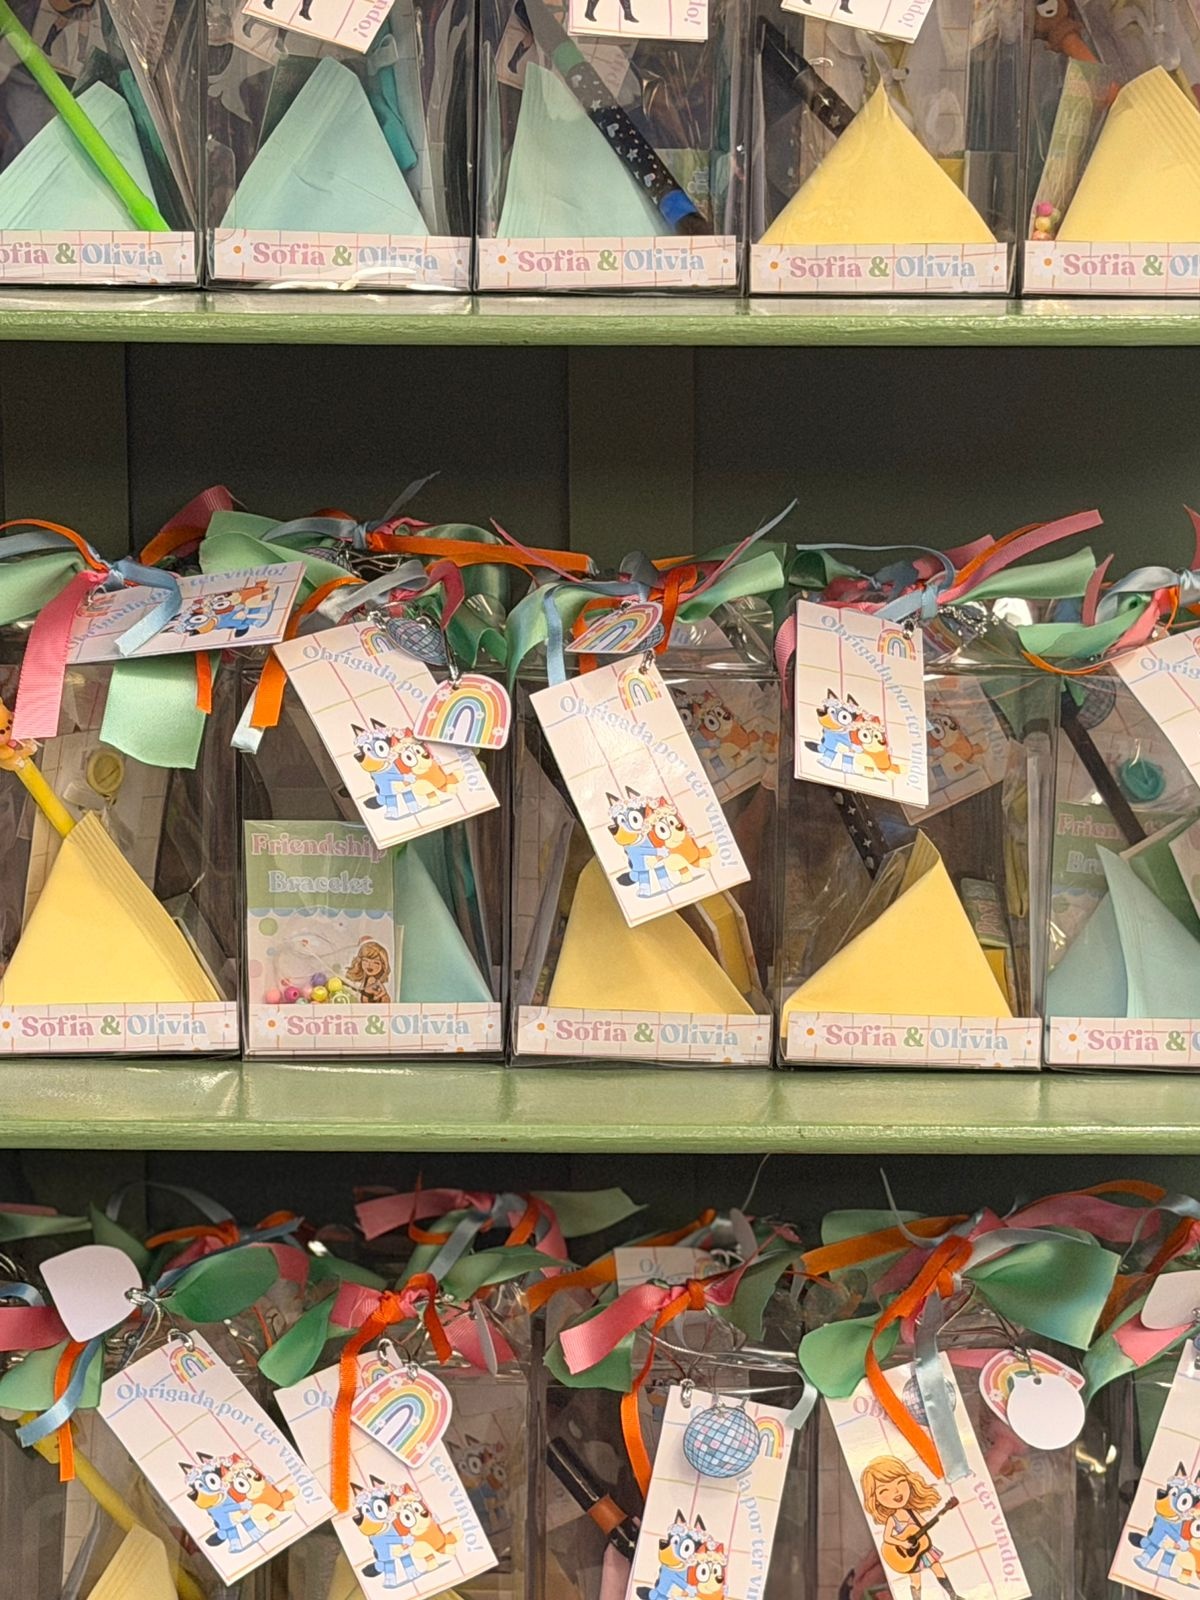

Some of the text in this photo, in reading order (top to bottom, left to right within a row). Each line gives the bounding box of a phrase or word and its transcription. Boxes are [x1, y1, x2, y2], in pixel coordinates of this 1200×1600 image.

[0, 241, 164, 266] ofia & Olivia
[252, 241, 438, 270] Sofia & Olivia
[517, 248, 705, 272] Sofia & Olivia
[789, 255, 976, 278] Sofia & Olivia
[1063, 253, 1136, 276] Sofia
[1142, 254, 1164, 276] &
[302, 645, 397, 684] Obrigada
[1140, 657, 1200, 679] Obrig
[820, 614, 925, 791] Obrigada por ter vindo!
[559, 695, 739, 867] Obrigada por ter vindo!
[251, 833, 387, 863] Friendship
[268, 870, 375, 895] Bracelet
[20, 1014, 208, 1037] Sofia & Olivia
[287, 1013, 471, 1036] Sofia & Olivia
[555, 1019, 739, 1046] Sofia & Olivia
[824, 1023, 1009, 1050] Sofia & Olivia
[1087, 1029, 1160, 1051] Sofia
[1165, 1030, 1187, 1051] &
[116, 1383, 322, 1504] Obrigada por ter vindo!
[430, 1456, 484, 1552] ter vindo!
[740, 1496, 762, 1533] por
[751, 1539, 766, 1570] ter
[973, 1481, 1022, 1583] ter vindo!
